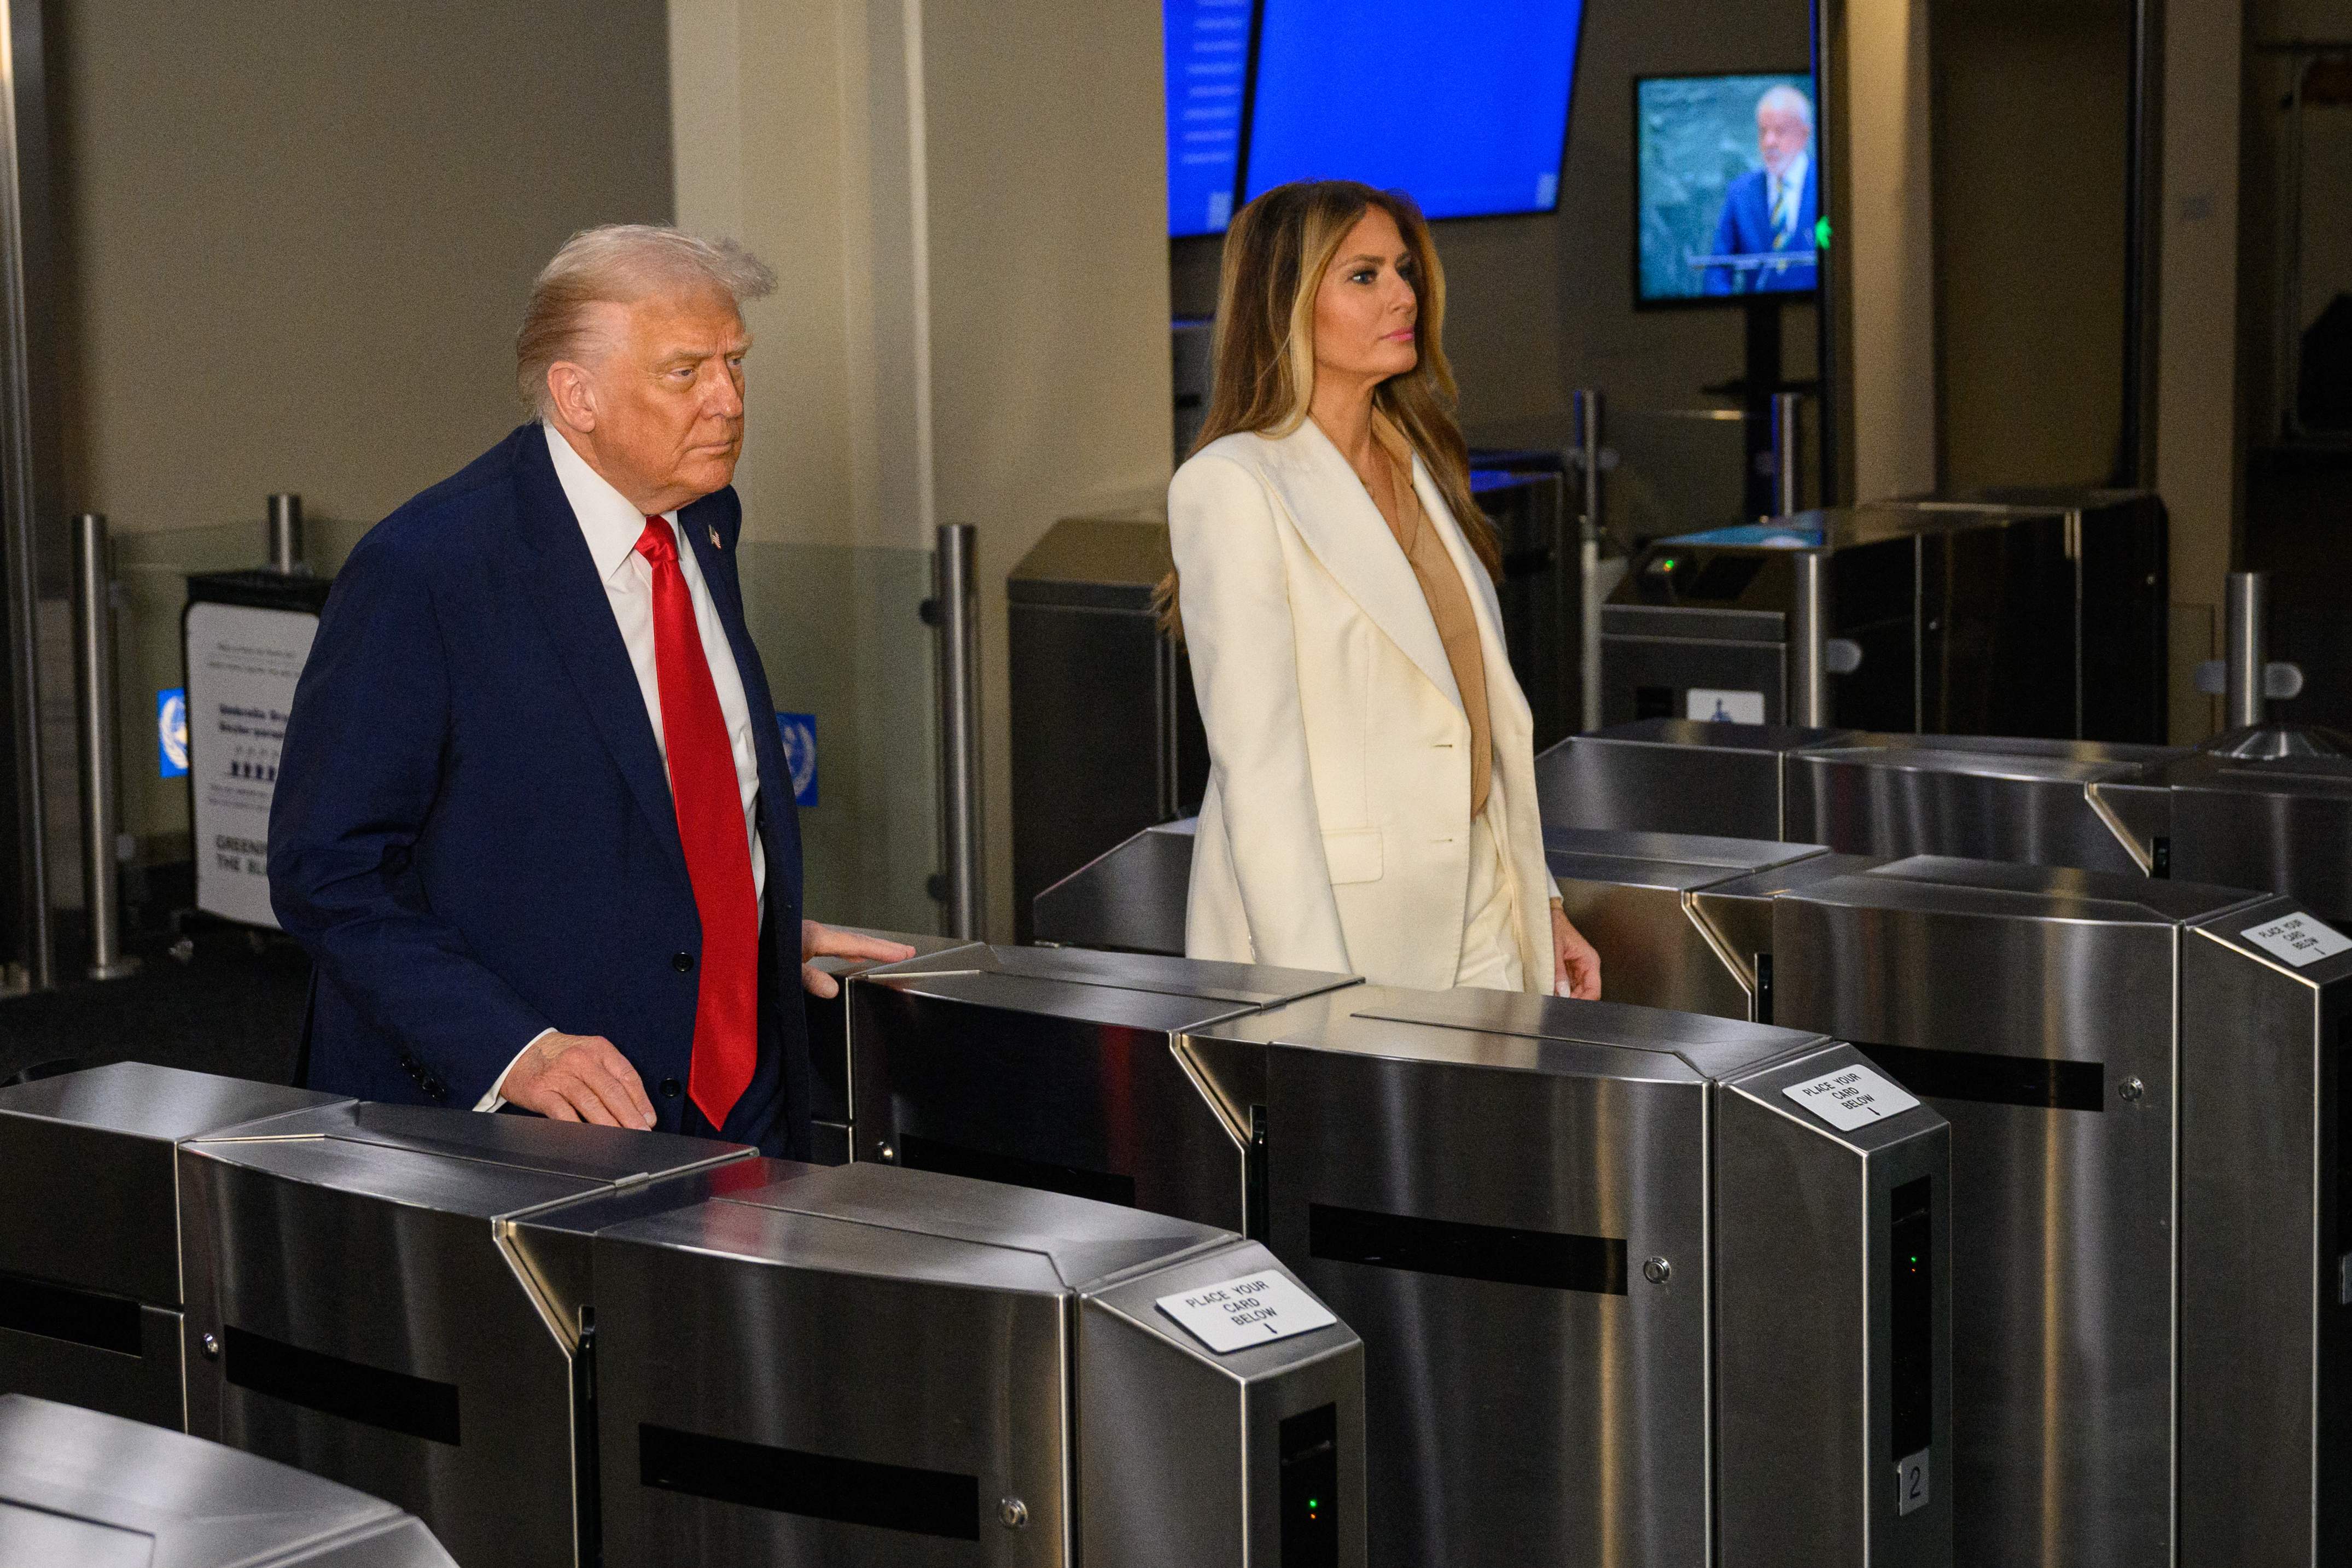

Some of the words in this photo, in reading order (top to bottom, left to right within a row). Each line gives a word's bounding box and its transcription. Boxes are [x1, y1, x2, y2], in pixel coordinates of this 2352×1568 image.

[1803, 1082, 1835, 1096] PLACE
[1833, 1074, 1861, 1085] YOUR
[1832, 1087, 1859, 1099] CARD
[1842, 1094, 1875, 1110] BELOW
[1186, 1291, 1230, 1307] PLACE
[1232, 1281, 1268, 1295] YOUR
[1223, 1298, 1260, 1313] CARD
[1231, 1308, 1278, 1326] BELOW
[1910, 1466, 1920, 1500] 2
